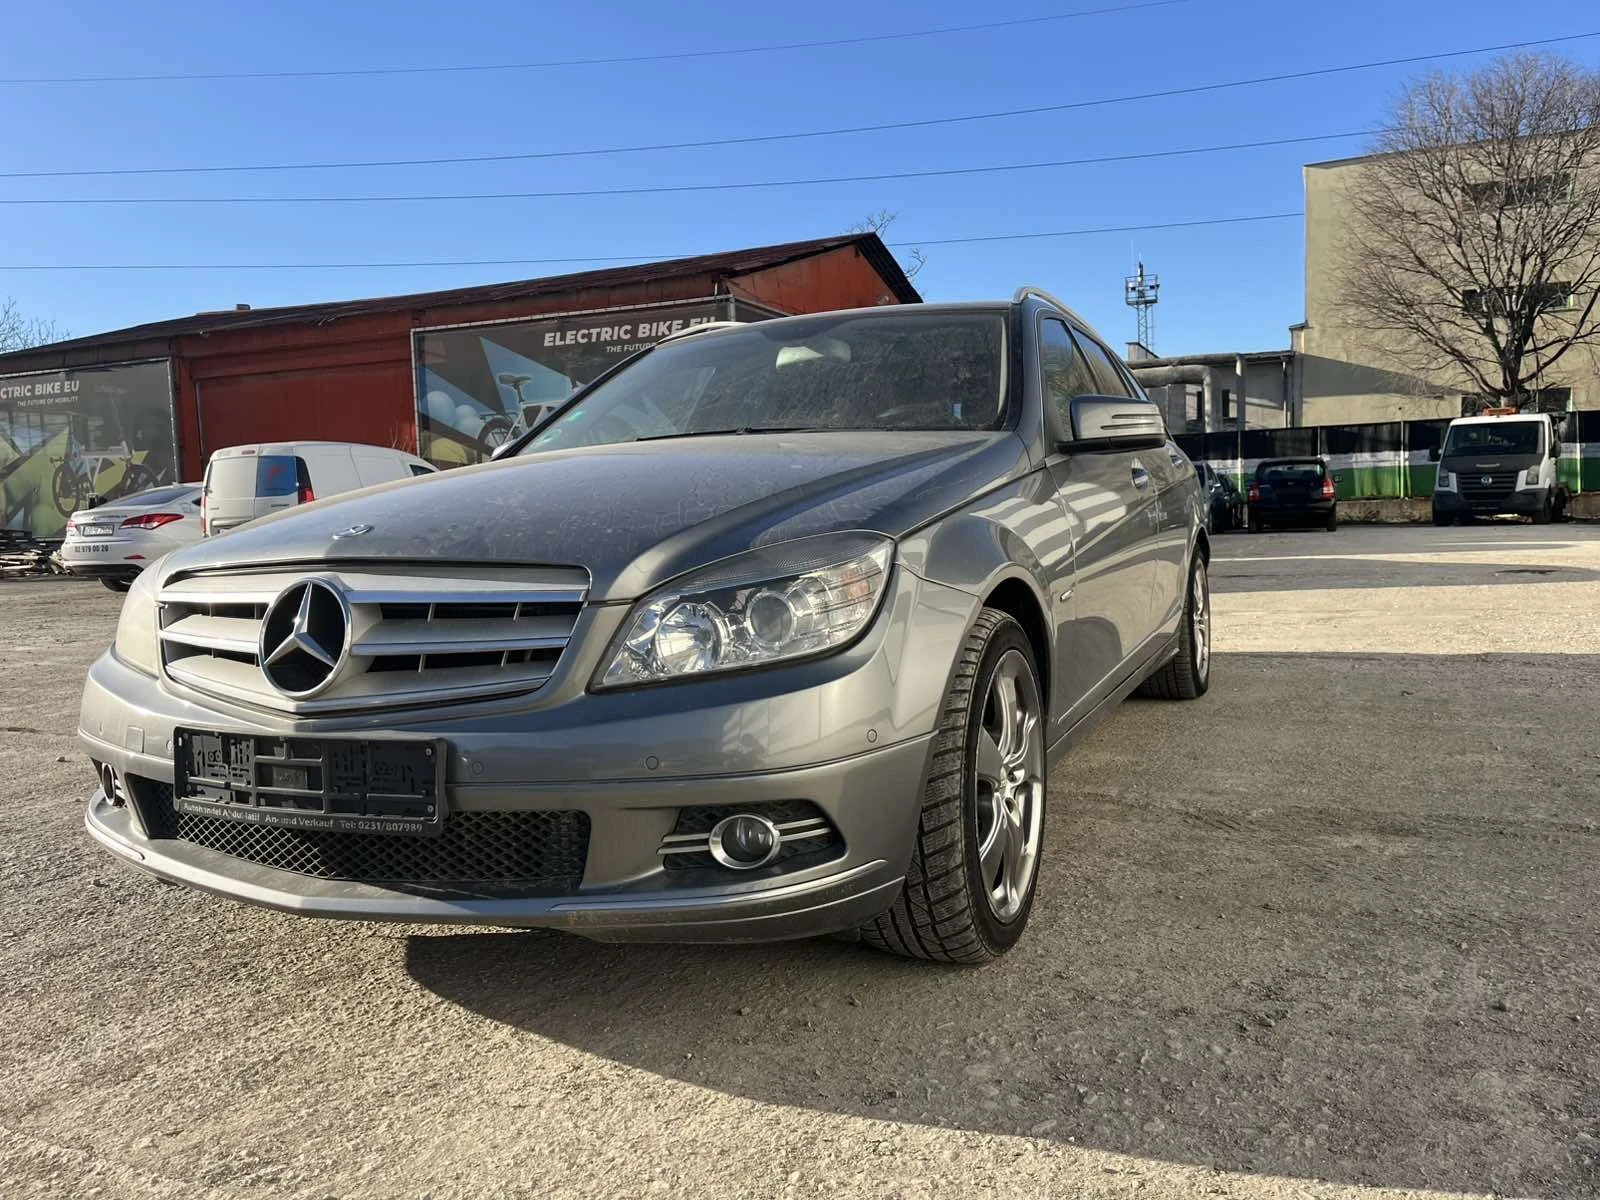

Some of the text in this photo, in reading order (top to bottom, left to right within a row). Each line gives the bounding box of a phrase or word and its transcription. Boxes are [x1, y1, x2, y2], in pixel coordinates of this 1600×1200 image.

[543, 324, 631, 347] ELECTRIC
[637, 319, 684, 339] BIKE
[606, 345, 622, 353] THE
[0, 379, 80, 399] CTRIC BIKE EU
[298, 816, 334, 828] Verkauf
